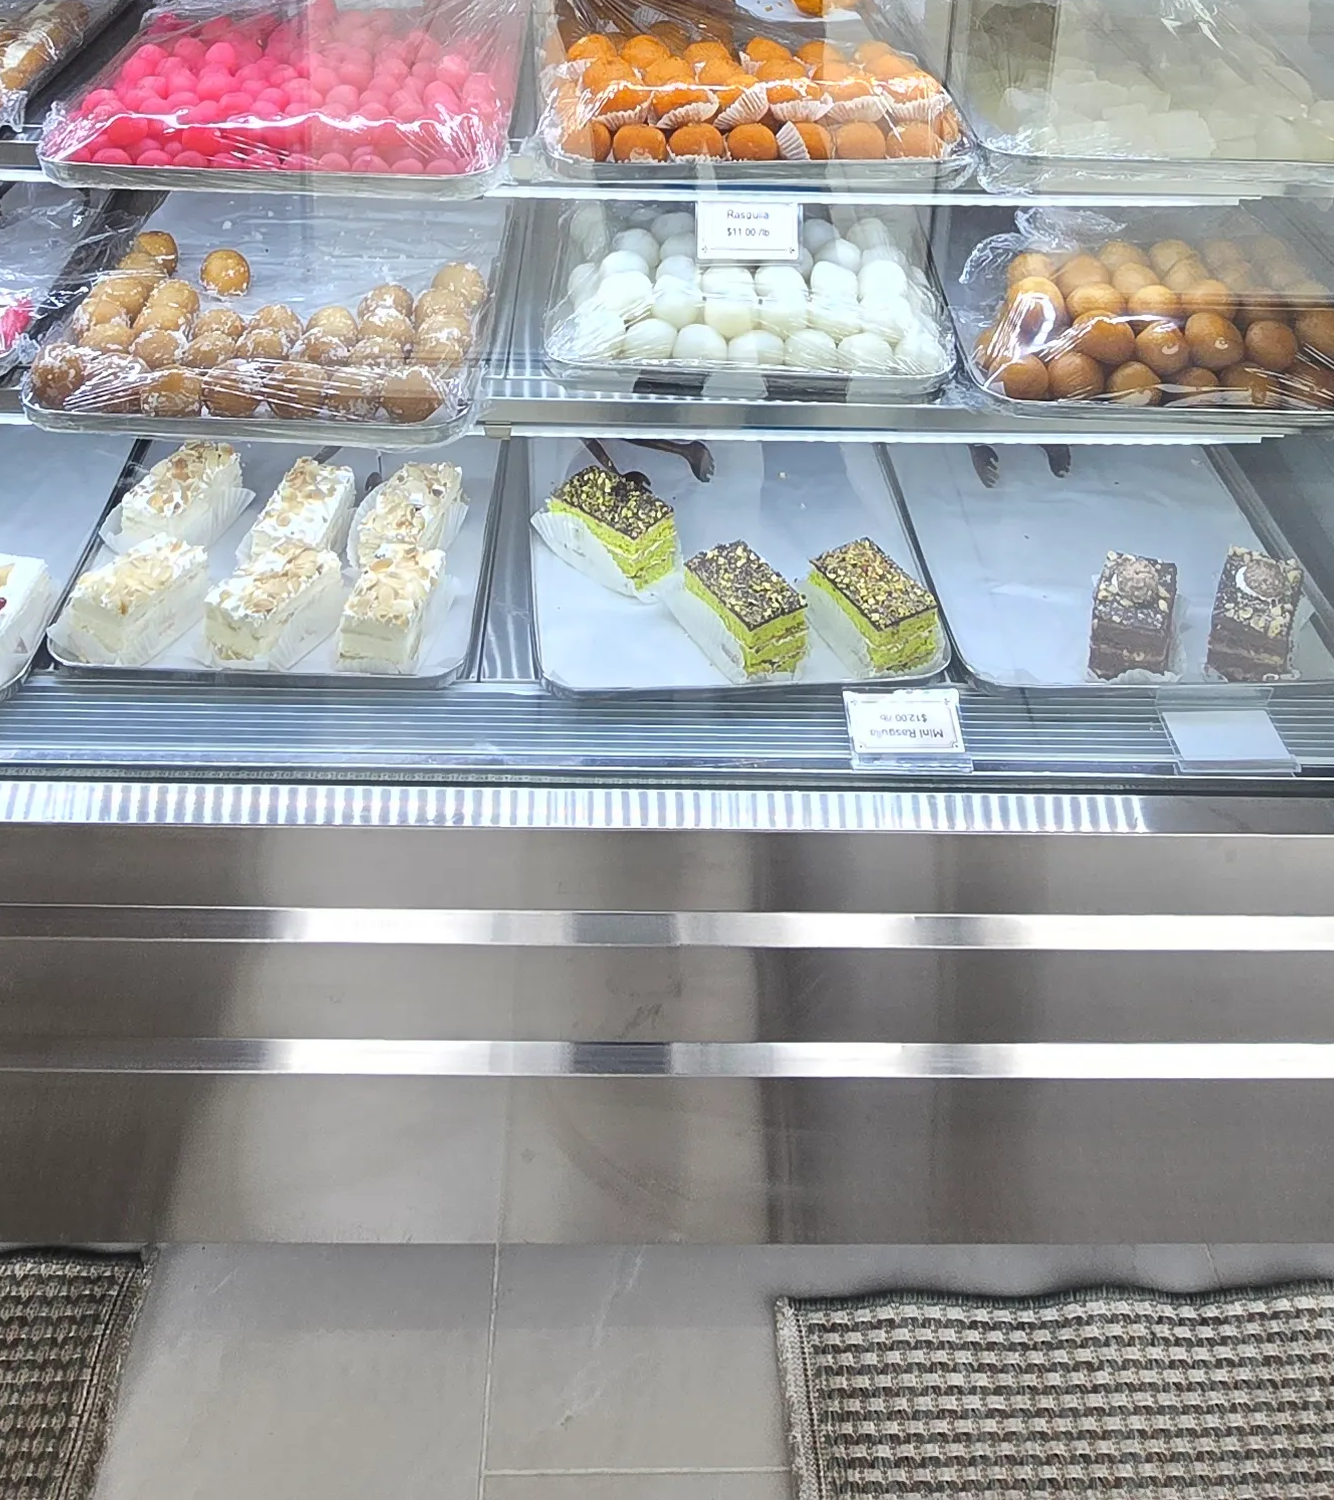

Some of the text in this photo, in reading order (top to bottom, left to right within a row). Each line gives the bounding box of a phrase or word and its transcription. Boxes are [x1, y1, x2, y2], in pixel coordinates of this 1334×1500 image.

[758, 228, 770, 237] /lb
[870, 727, 944, 739] Mini Rasgulla
